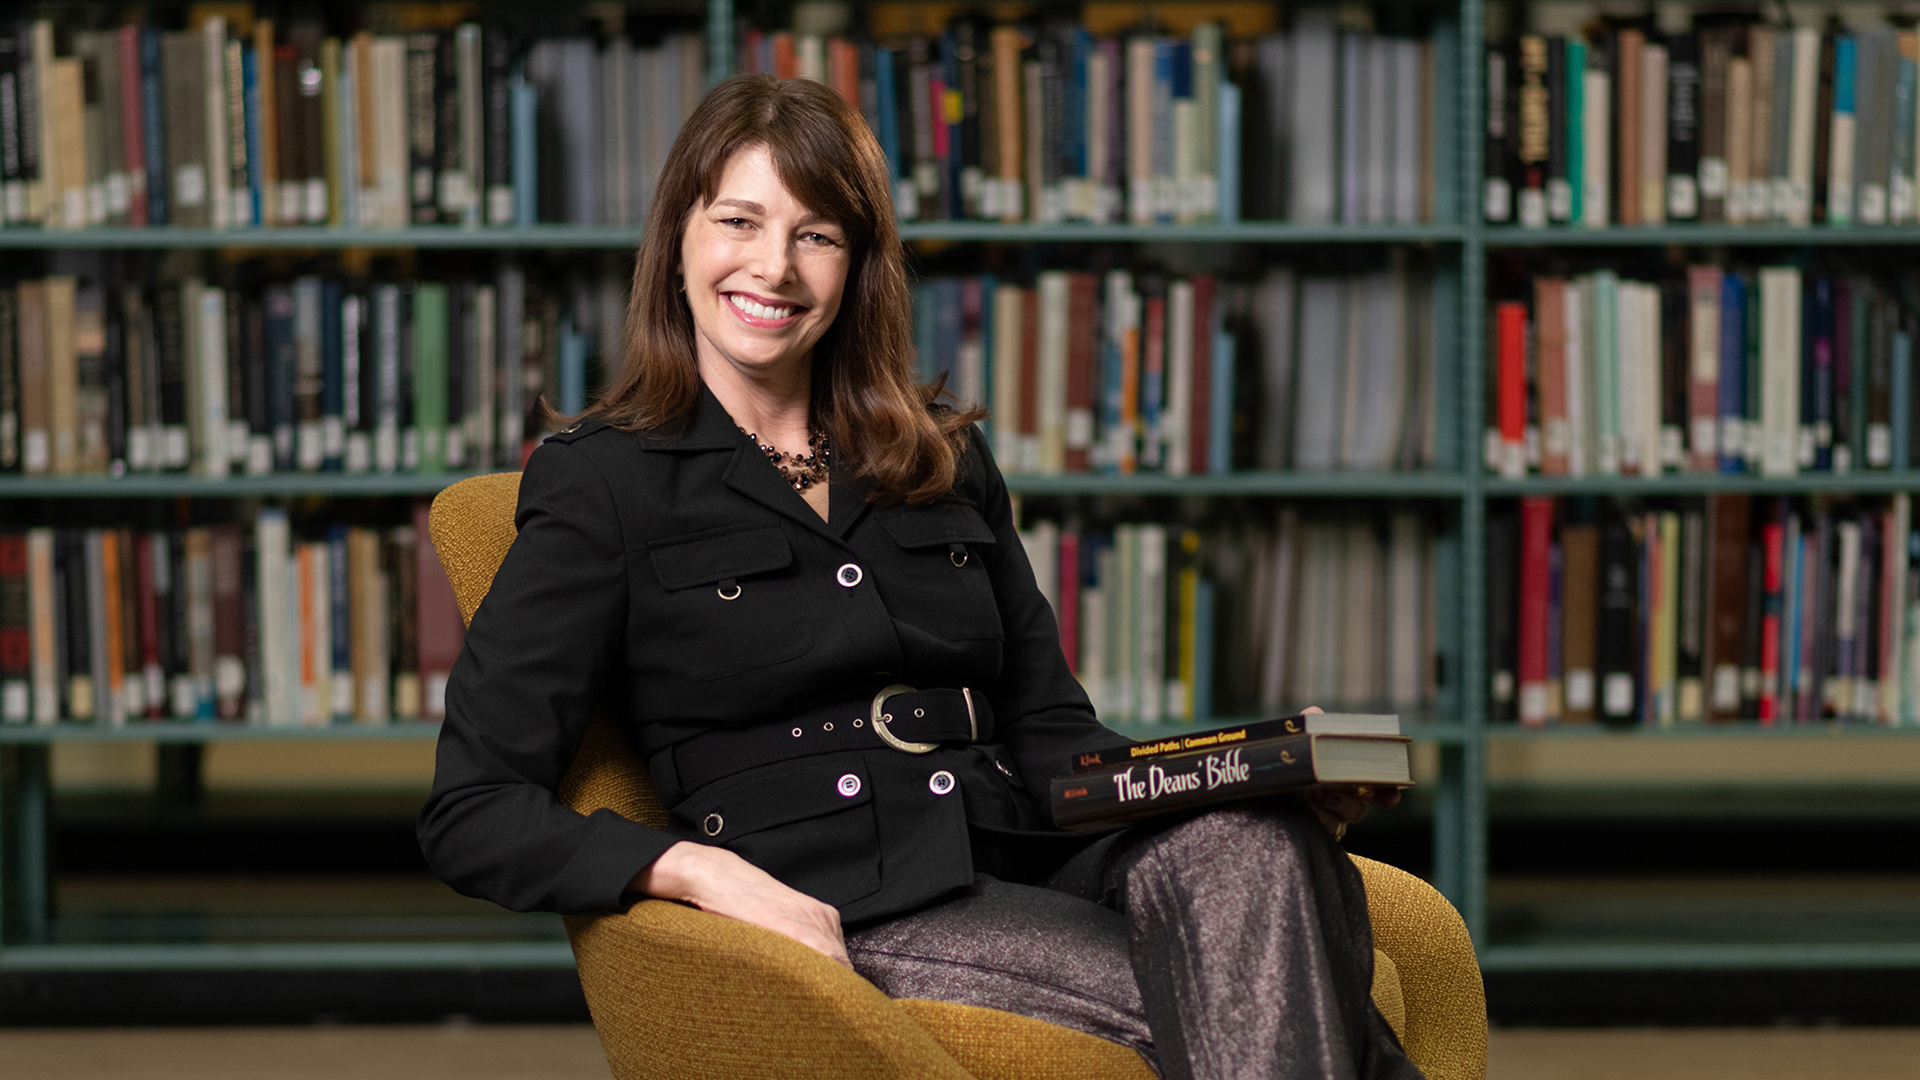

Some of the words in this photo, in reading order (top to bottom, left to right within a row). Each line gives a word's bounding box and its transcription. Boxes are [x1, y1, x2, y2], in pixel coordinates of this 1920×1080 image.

[1130, 743, 1159, 757] Divided
[1159, 740, 1180, 752] Paths
[1185, 734, 1218, 748] Common
[1217, 728, 1246, 743] Ground
[1113, 765, 1147, 802] The
[1206, 747, 1250, 790] Bible
[1064, 787, 1088, 799] Klink
